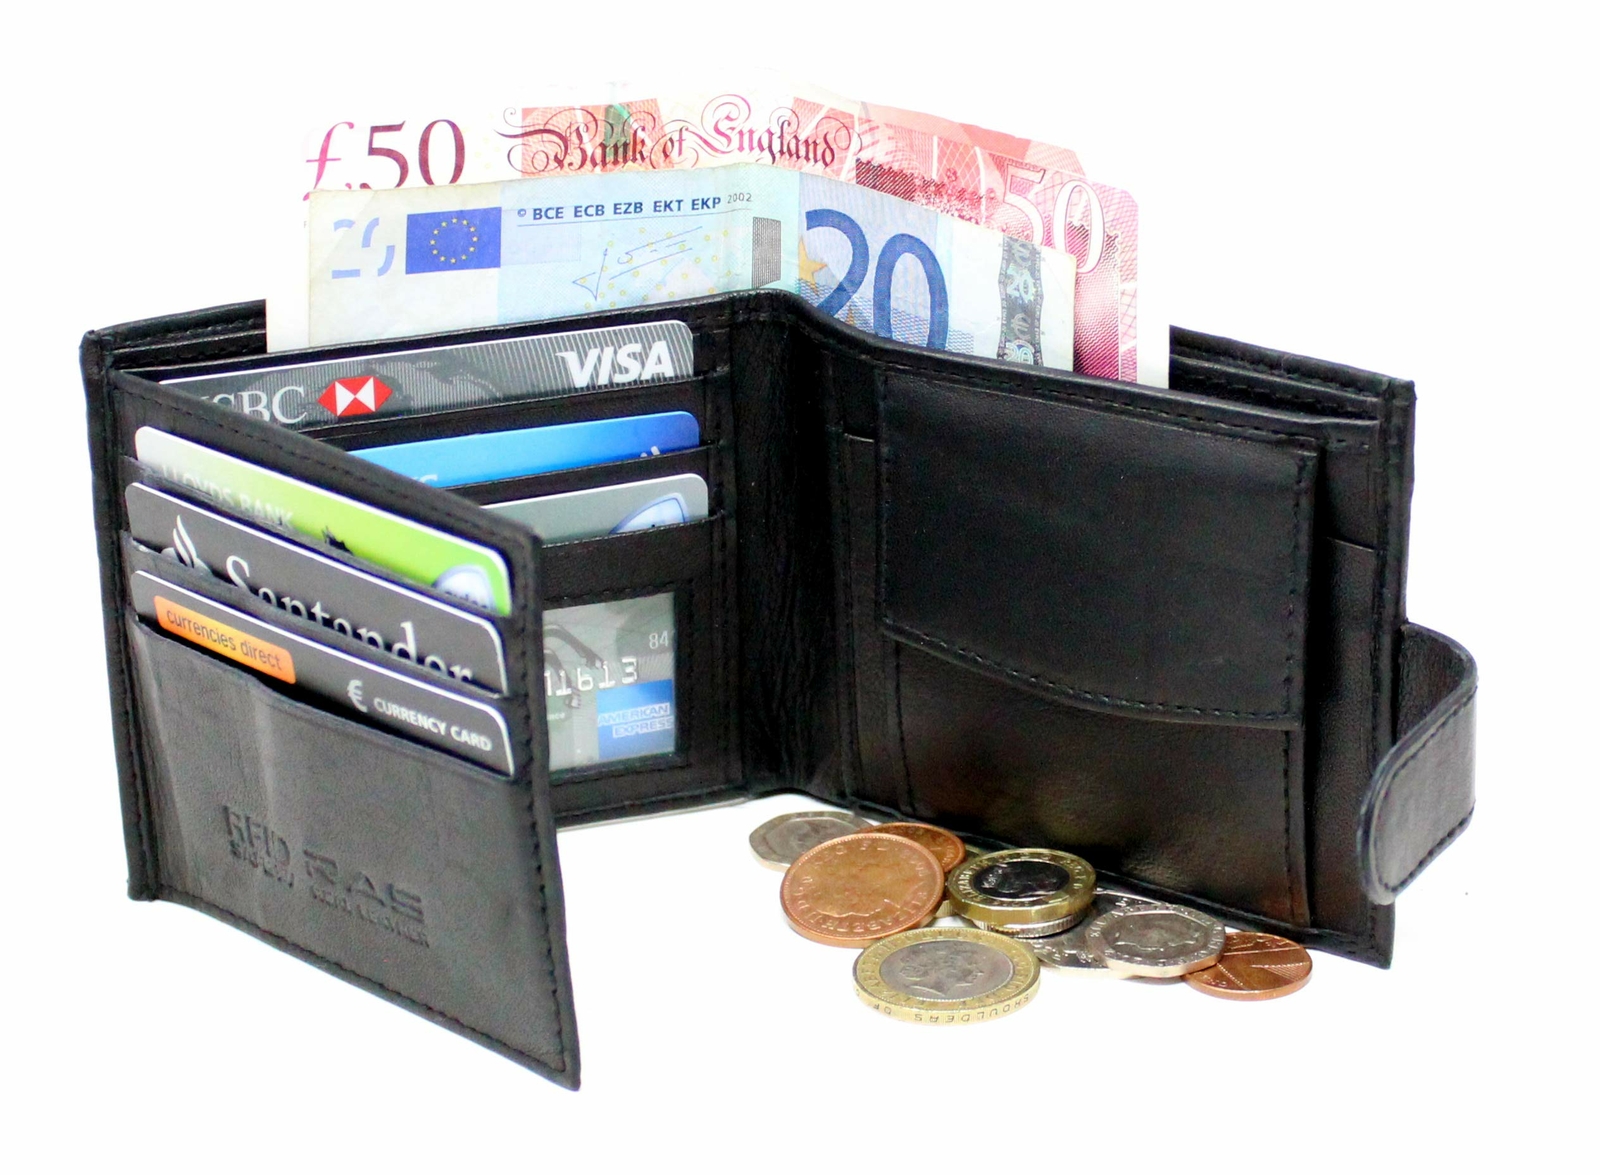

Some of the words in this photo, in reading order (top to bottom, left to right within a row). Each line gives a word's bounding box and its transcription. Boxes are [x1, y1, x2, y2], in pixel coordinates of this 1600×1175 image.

[500, 107, 650, 171] Bank
[659, 124, 692, 163] of
[698, 94, 855, 167] England
[532, 205, 564, 221] BCE
[573, 203, 605, 218] ECB
[612, 201, 644, 216] EZB
[653, 198, 684, 214] EKT
[690, 196, 722, 212] EKP
[726, 192, 753, 204] 2002
[1002, 162, 1105, 274] 50
[805, 207, 949, 350] 20
[555, 340, 674, 389] VISA
[165, 608, 237, 652] currencies
[239, 639, 283, 671] direct
[648, 630, 669, 650] 84
[373, 697, 448, 738] CURRENCY
[449, 725, 493, 751] CARD
[598, 704, 669, 727] AMERICAN
[613, 717, 674, 737] EXPRESS
